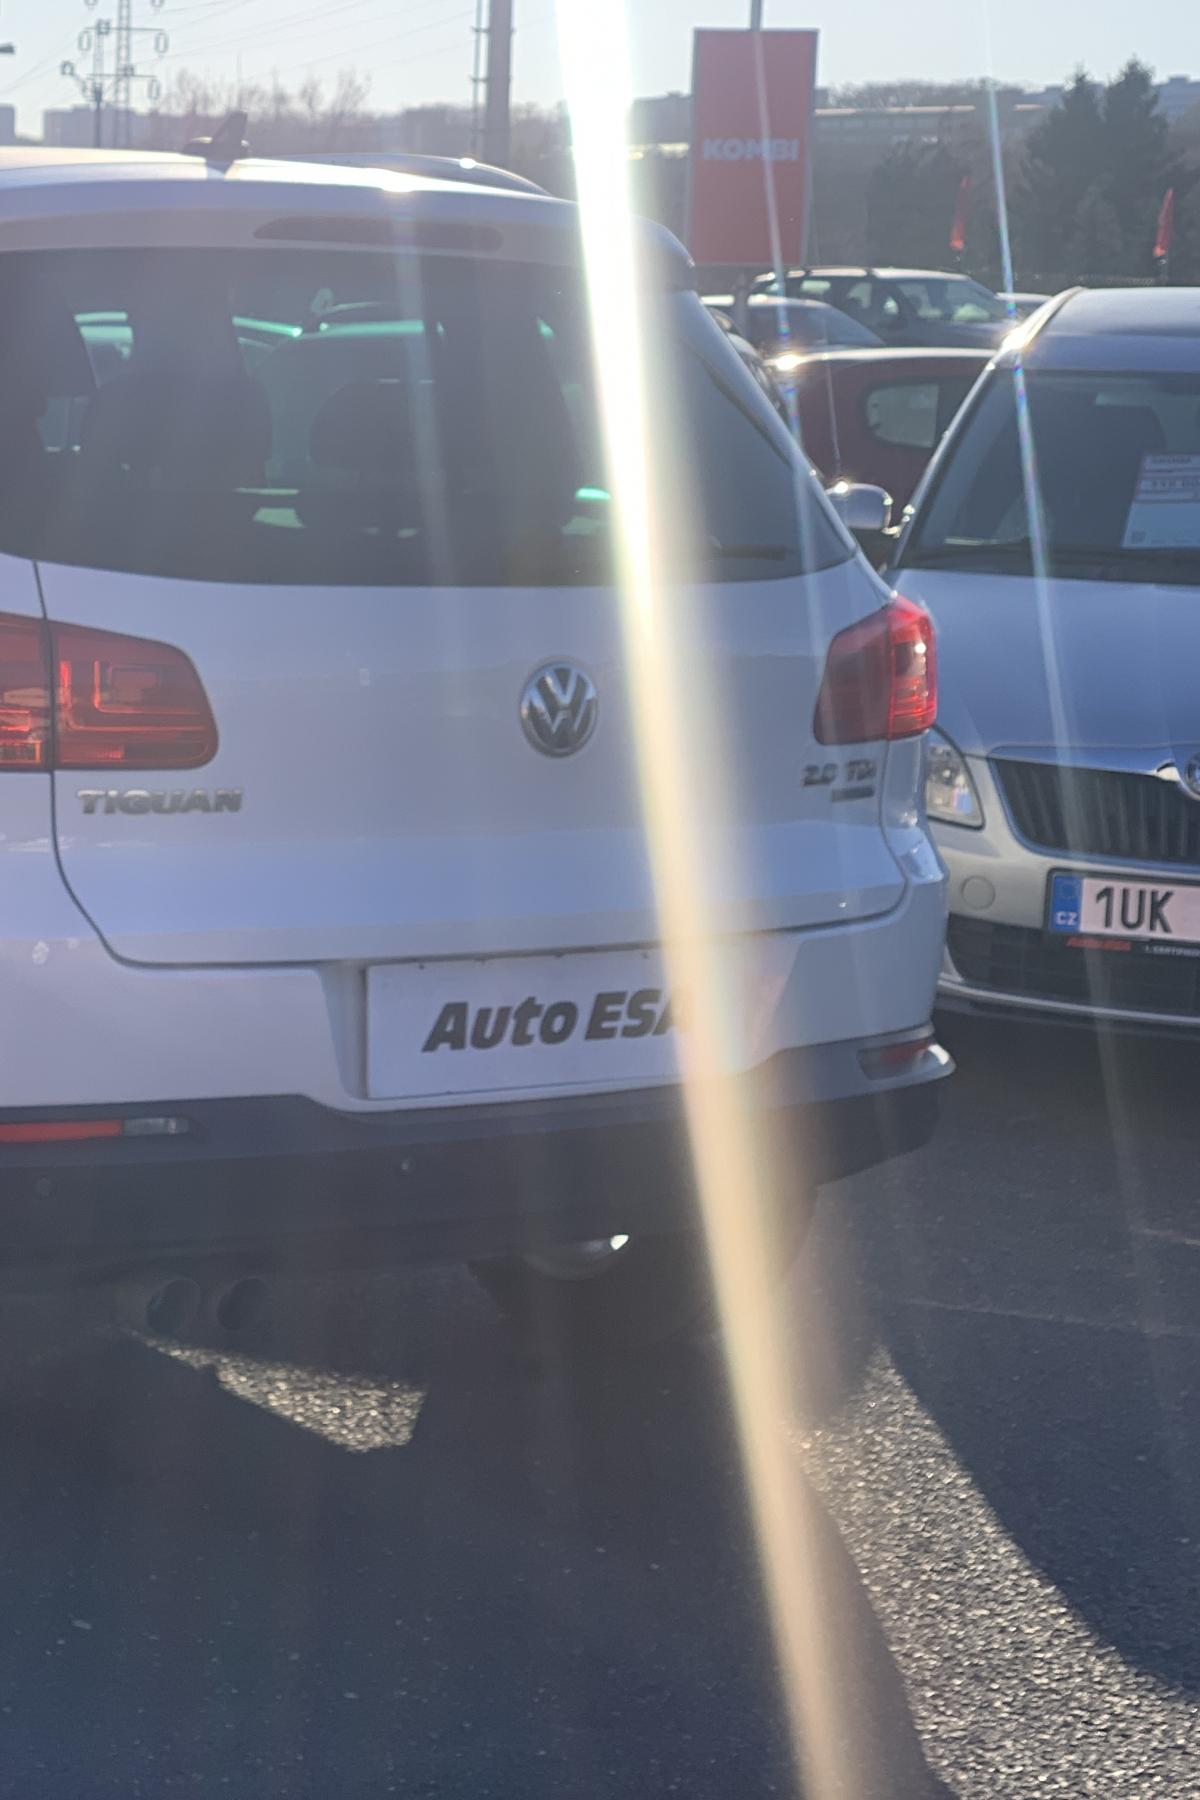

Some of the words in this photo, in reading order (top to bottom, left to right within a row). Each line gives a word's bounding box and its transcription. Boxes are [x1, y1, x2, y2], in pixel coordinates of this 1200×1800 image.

[703, 138, 799, 160] KOMBI
[79, 789, 243, 815] TIGUAN
[1056, 912, 1078, 926] CZ
[1096, 886, 1174, 934] 1UK
[421, 996, 579, 1053] Auto
